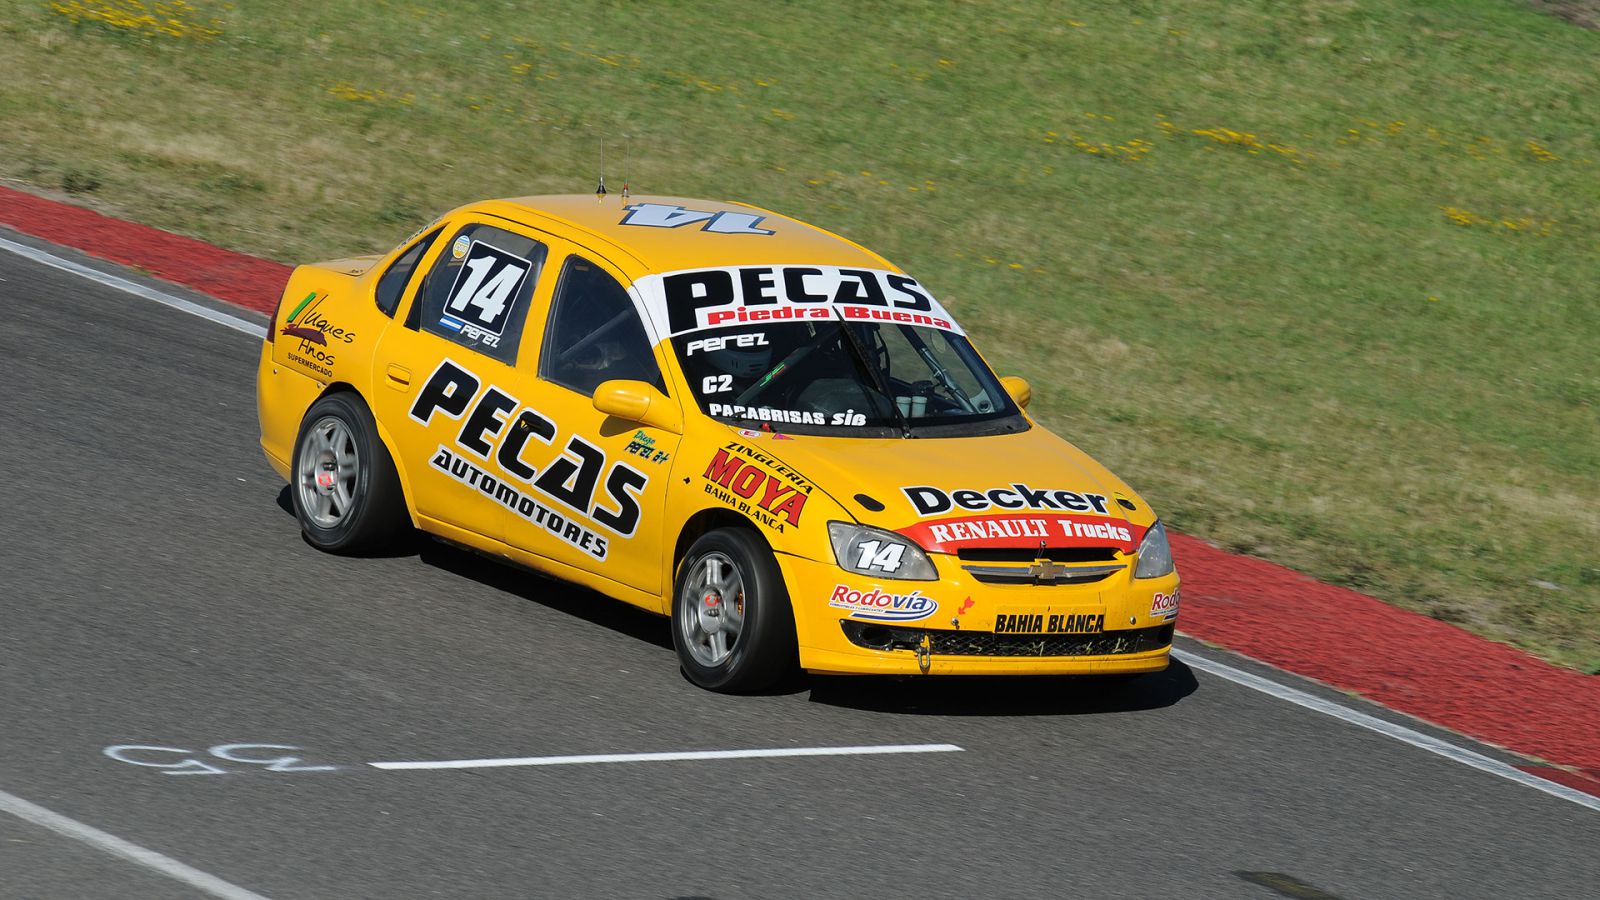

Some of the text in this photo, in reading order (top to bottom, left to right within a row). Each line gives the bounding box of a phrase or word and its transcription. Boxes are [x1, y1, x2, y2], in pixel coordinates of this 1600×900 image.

[619, 203, 776, 236] 14
[450, 255, 526, 324] 14
[662, 267, 932, 334] PECAS
[707, 306, 952, 329] Piedra Buena
[287, 352, 333, 378] SUPERMERCADO
[702, 374, 733, 394] C2
[408, 358, 649, 538] PECAS
[725, 441, 813, 495] ZINGUERIA
[430, 446, 609, 560] AUTOMOTORES
[702, 447, 808, 529] MOYA
[902, 484, 1109, 515] Decker
[704, 483, 785, 534] BAHIA BLANCA
[929, 518, 1132, 544] RENAULT Trucks
[856, 540, 907, 573] 14
[831, 585, 928, 610] Rodovía
[995, 614, 1104, 633] BAHIA BLANCA
